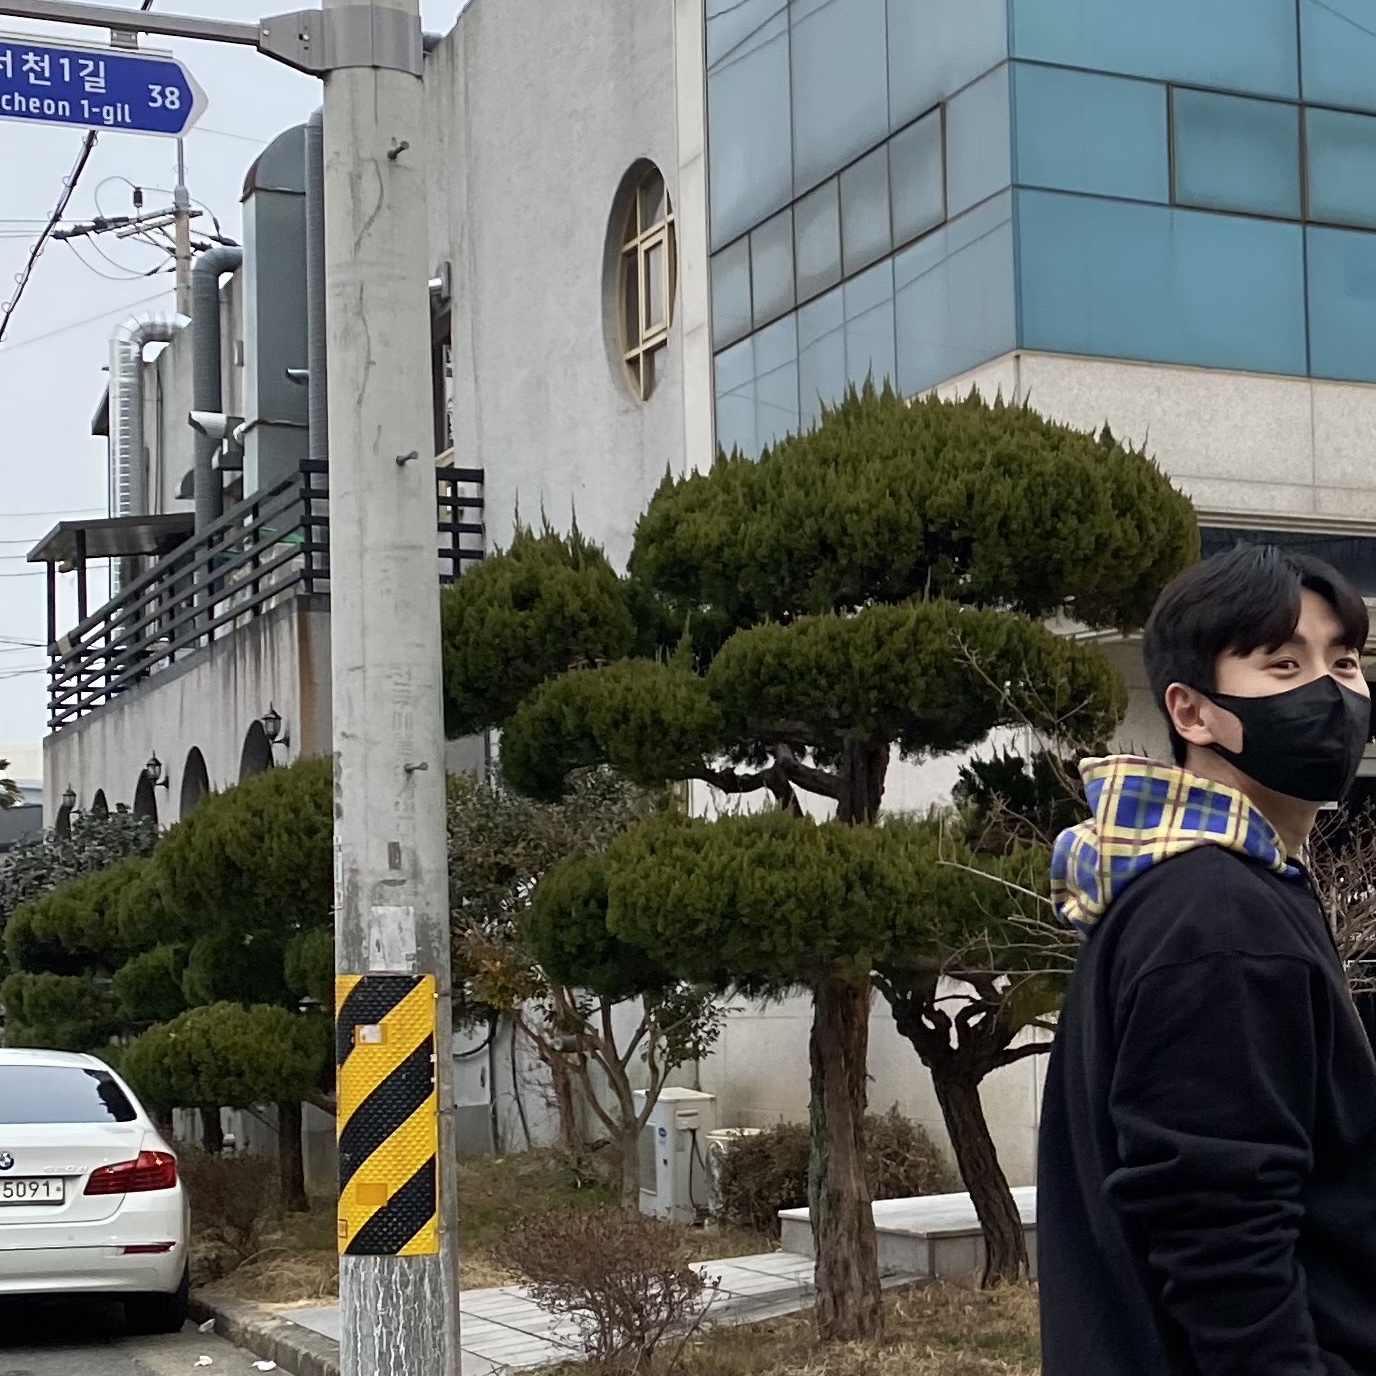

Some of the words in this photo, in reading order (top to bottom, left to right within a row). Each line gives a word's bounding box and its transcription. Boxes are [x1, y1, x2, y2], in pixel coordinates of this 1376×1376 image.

[147, 83, 181, 110] 38
[80, 98, 132, 125] 1-gil
[2, 1180, 51, 1199] 5091
